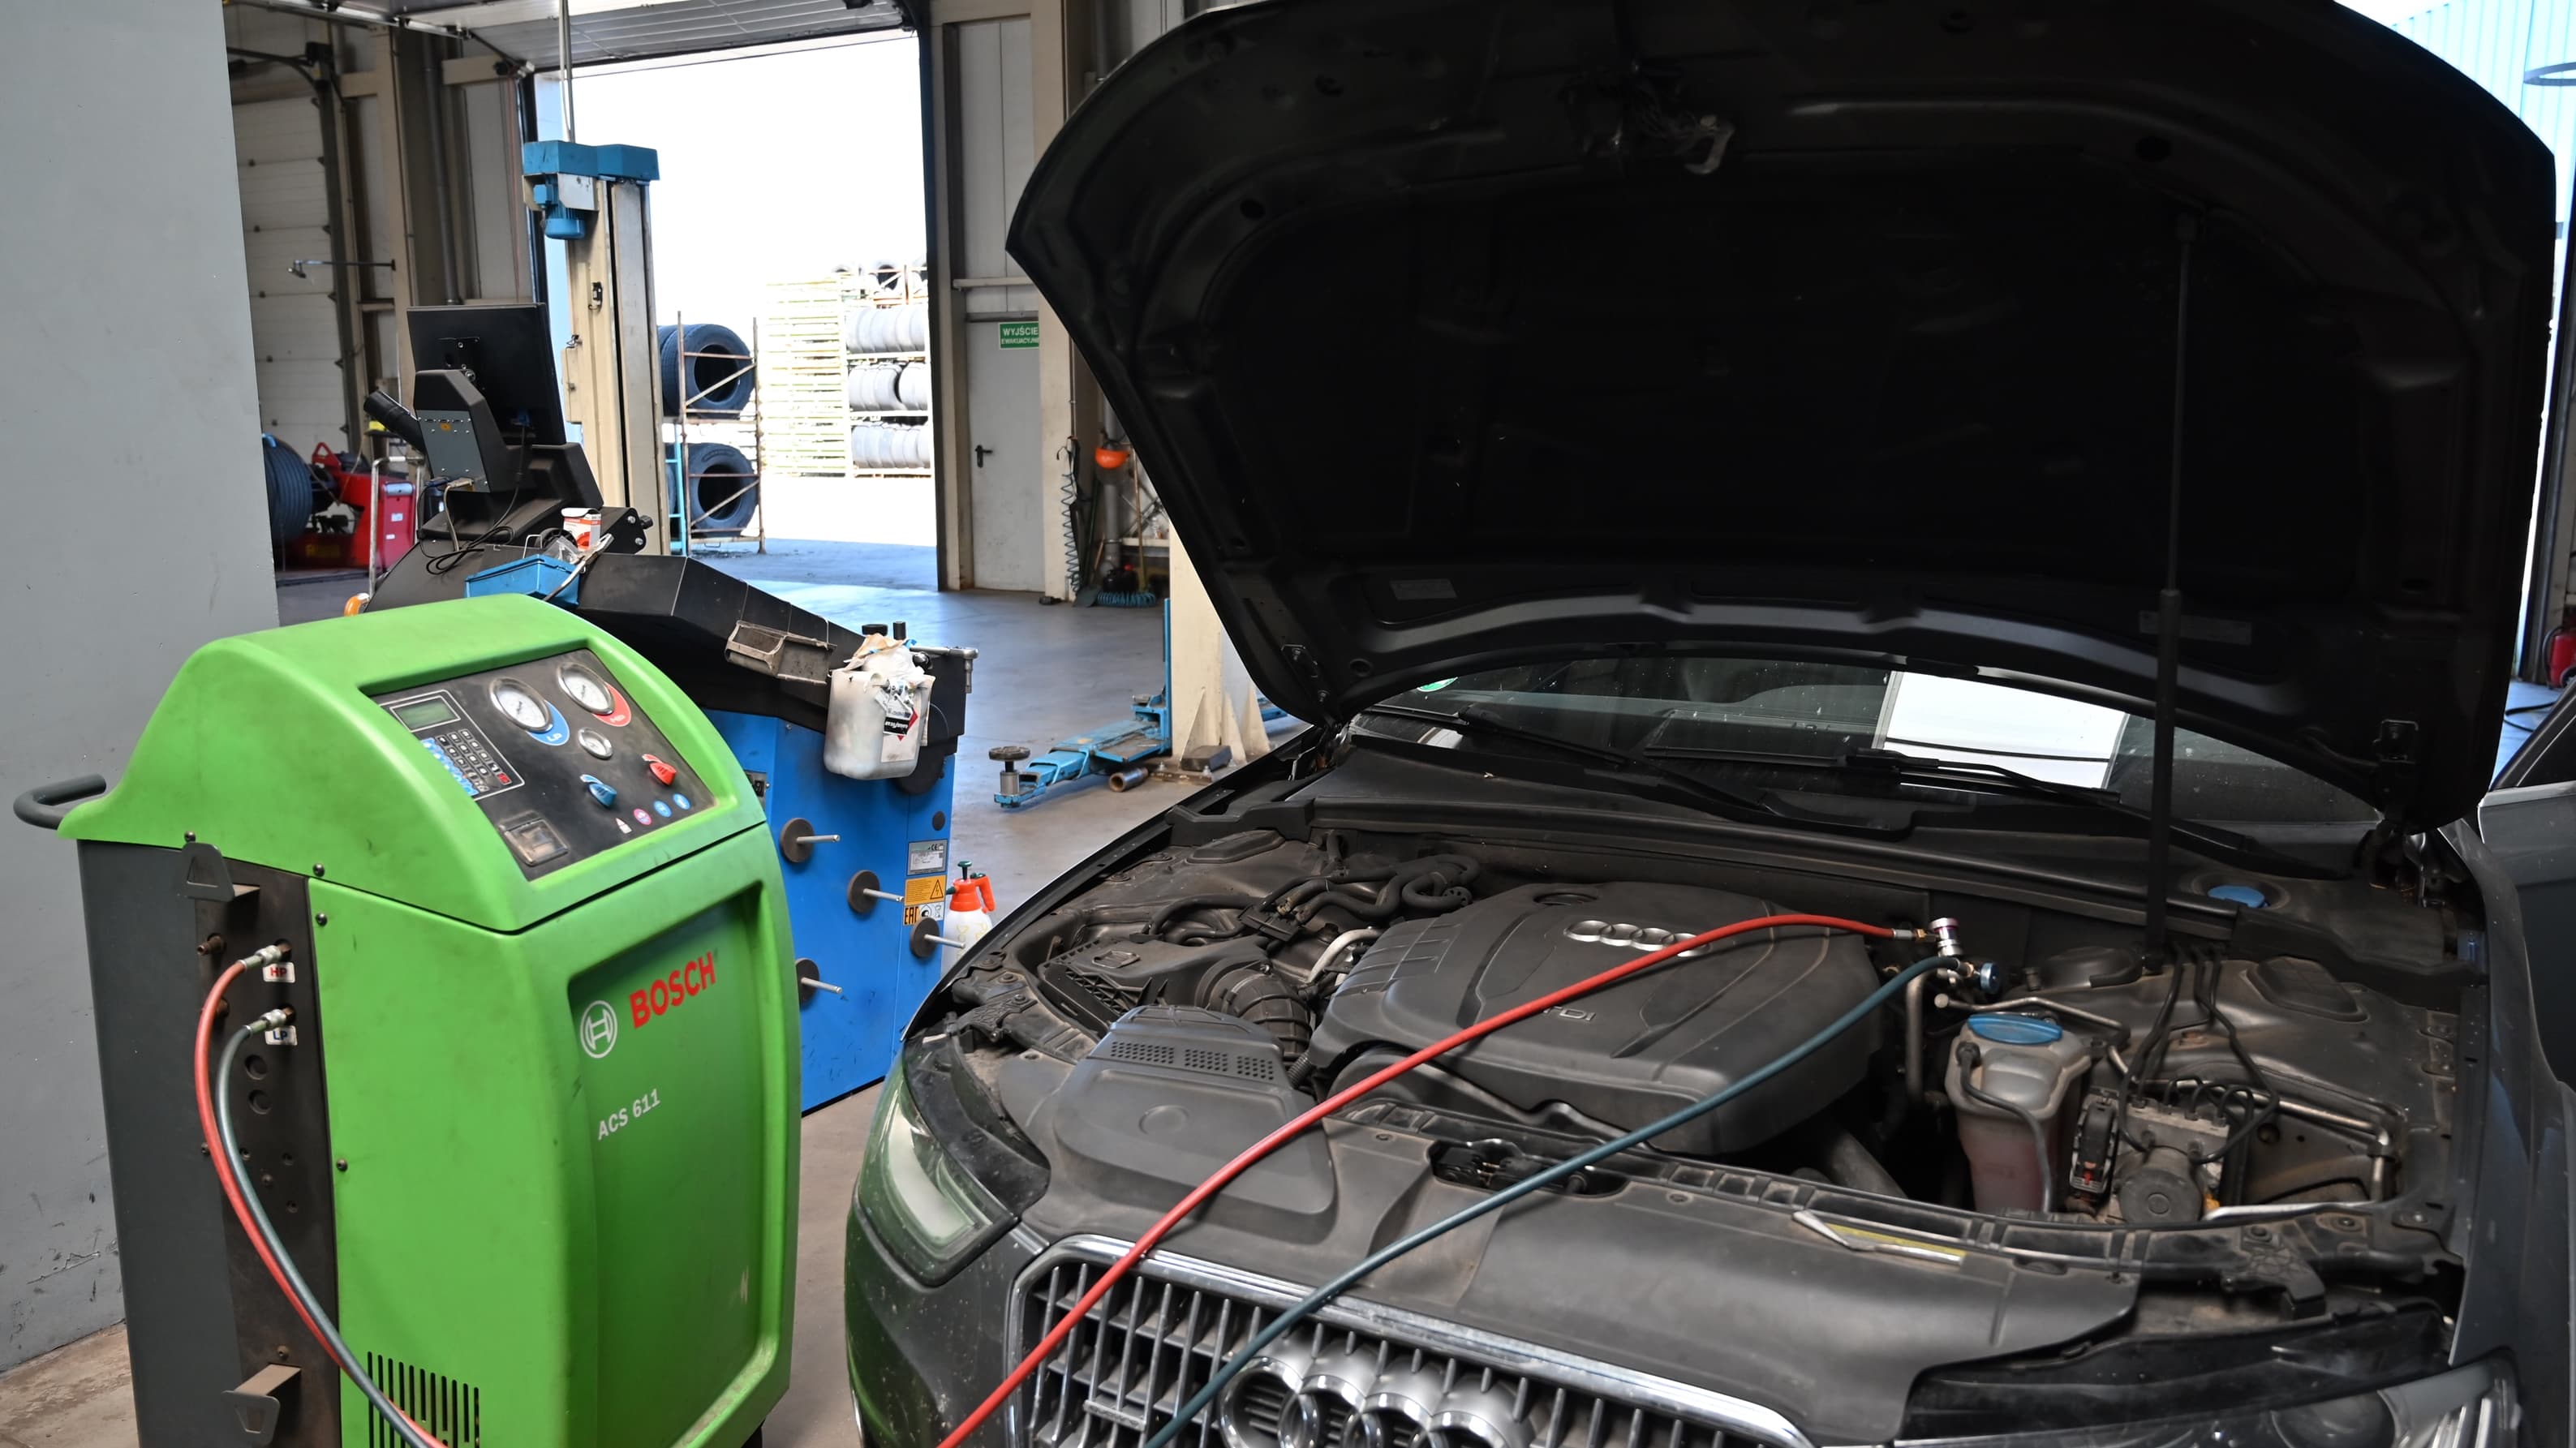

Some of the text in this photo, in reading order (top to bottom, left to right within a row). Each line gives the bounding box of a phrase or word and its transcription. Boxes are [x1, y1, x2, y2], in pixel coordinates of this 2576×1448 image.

[1003, 325, 1039, 336] WYJŚCIE
[546, 733, 562, 741] LP
[270, 966, 287, 977] HP
[630, 952, 716, 1029] BOSCH
[273, 1030, 287, 1040] LP
[598, 1089, 660, 1140] ACS 611
